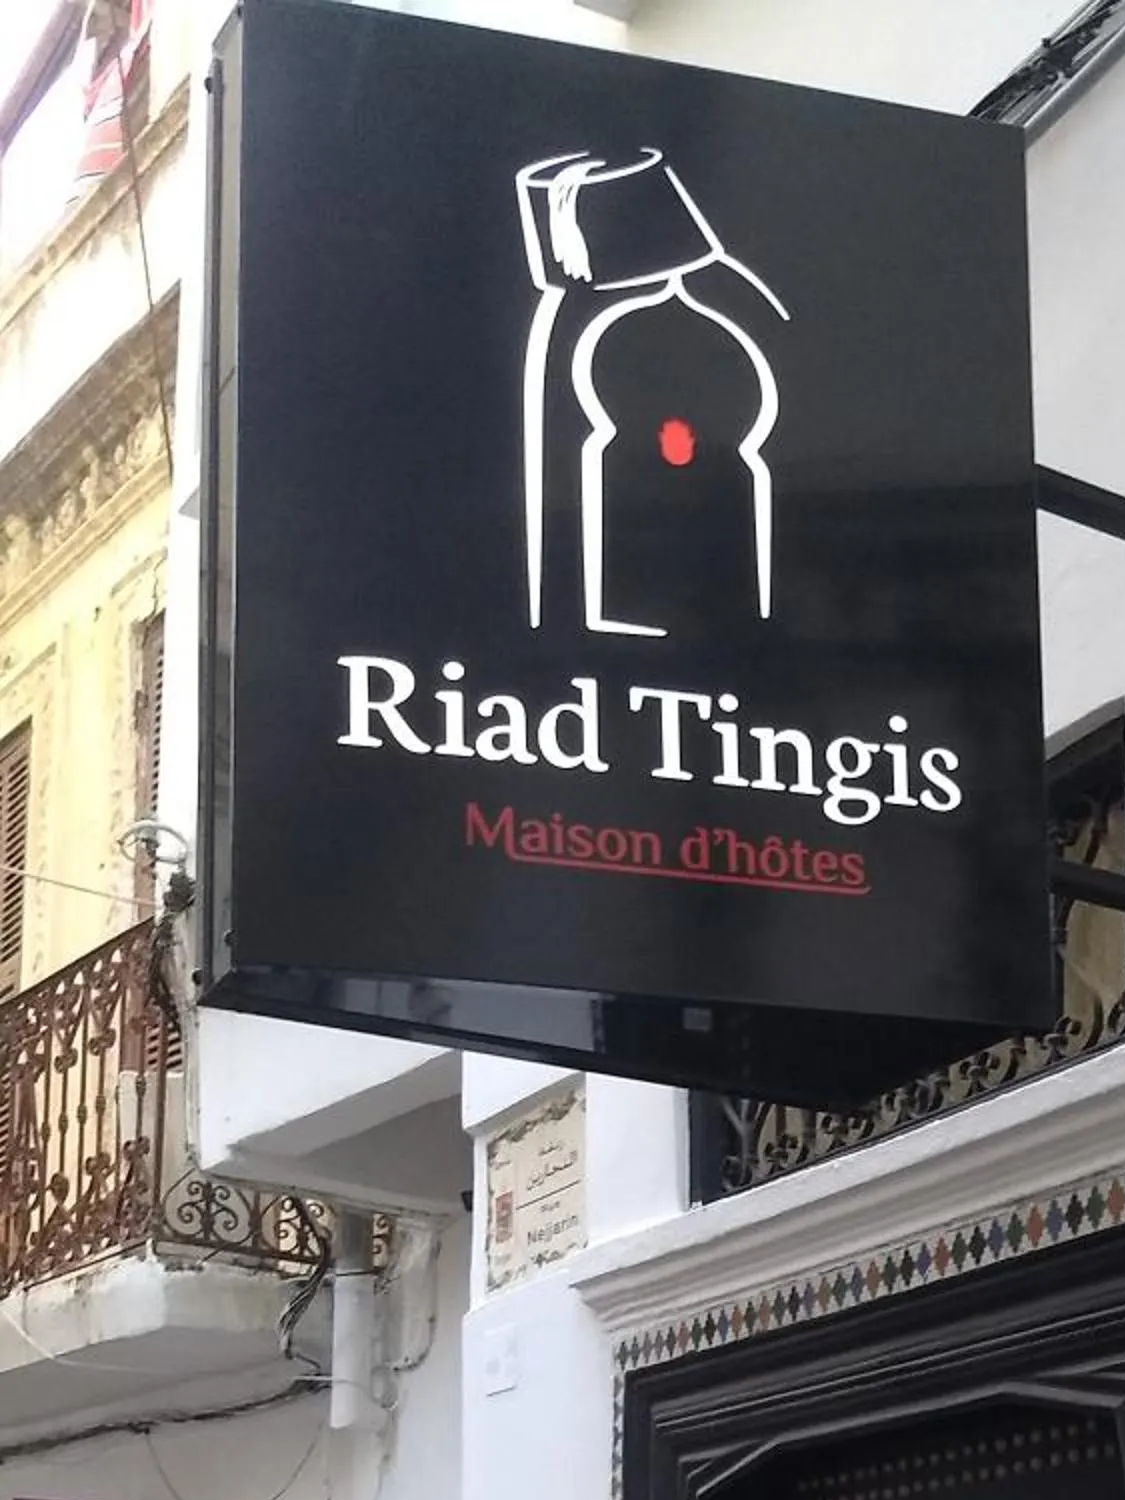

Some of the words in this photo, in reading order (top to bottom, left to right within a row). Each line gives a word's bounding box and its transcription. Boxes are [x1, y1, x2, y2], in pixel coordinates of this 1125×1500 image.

[337, 655, 610, 773] Riad
[629, 686, 963, 826] Tingis
[464, 802, 662, 866] Maison
